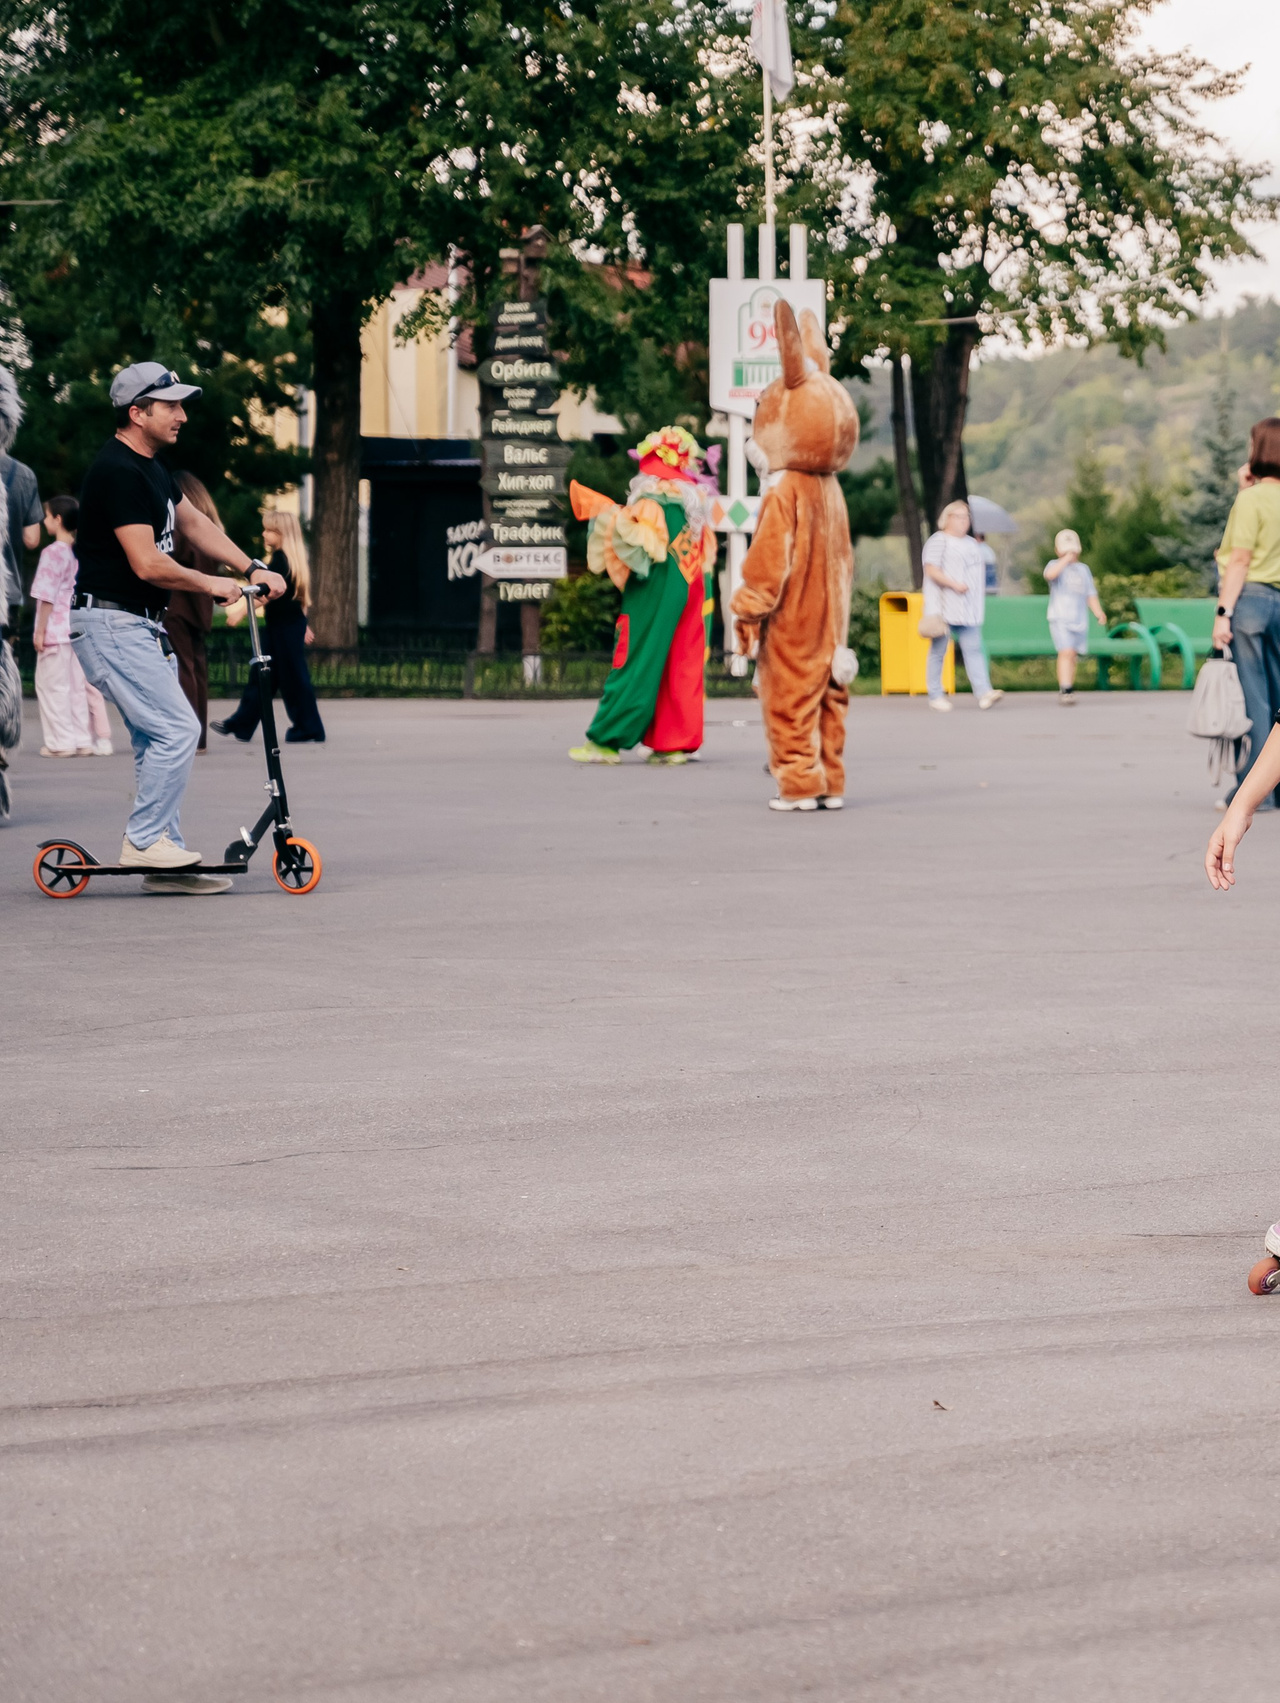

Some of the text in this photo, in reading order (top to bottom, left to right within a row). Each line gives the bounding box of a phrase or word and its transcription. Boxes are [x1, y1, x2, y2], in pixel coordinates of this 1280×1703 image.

[491, 359, 553, 382] Орбита
[491, 418, 553, 436] Рейнджер
[503, 444, 549, 465] Вальс
[497, 471, 555, 491] Хип-хоп
[490, 522, 564, 544] Траффик
[447, 541, 487, 581] КО
[497, 581, 551, 602] Туалет
